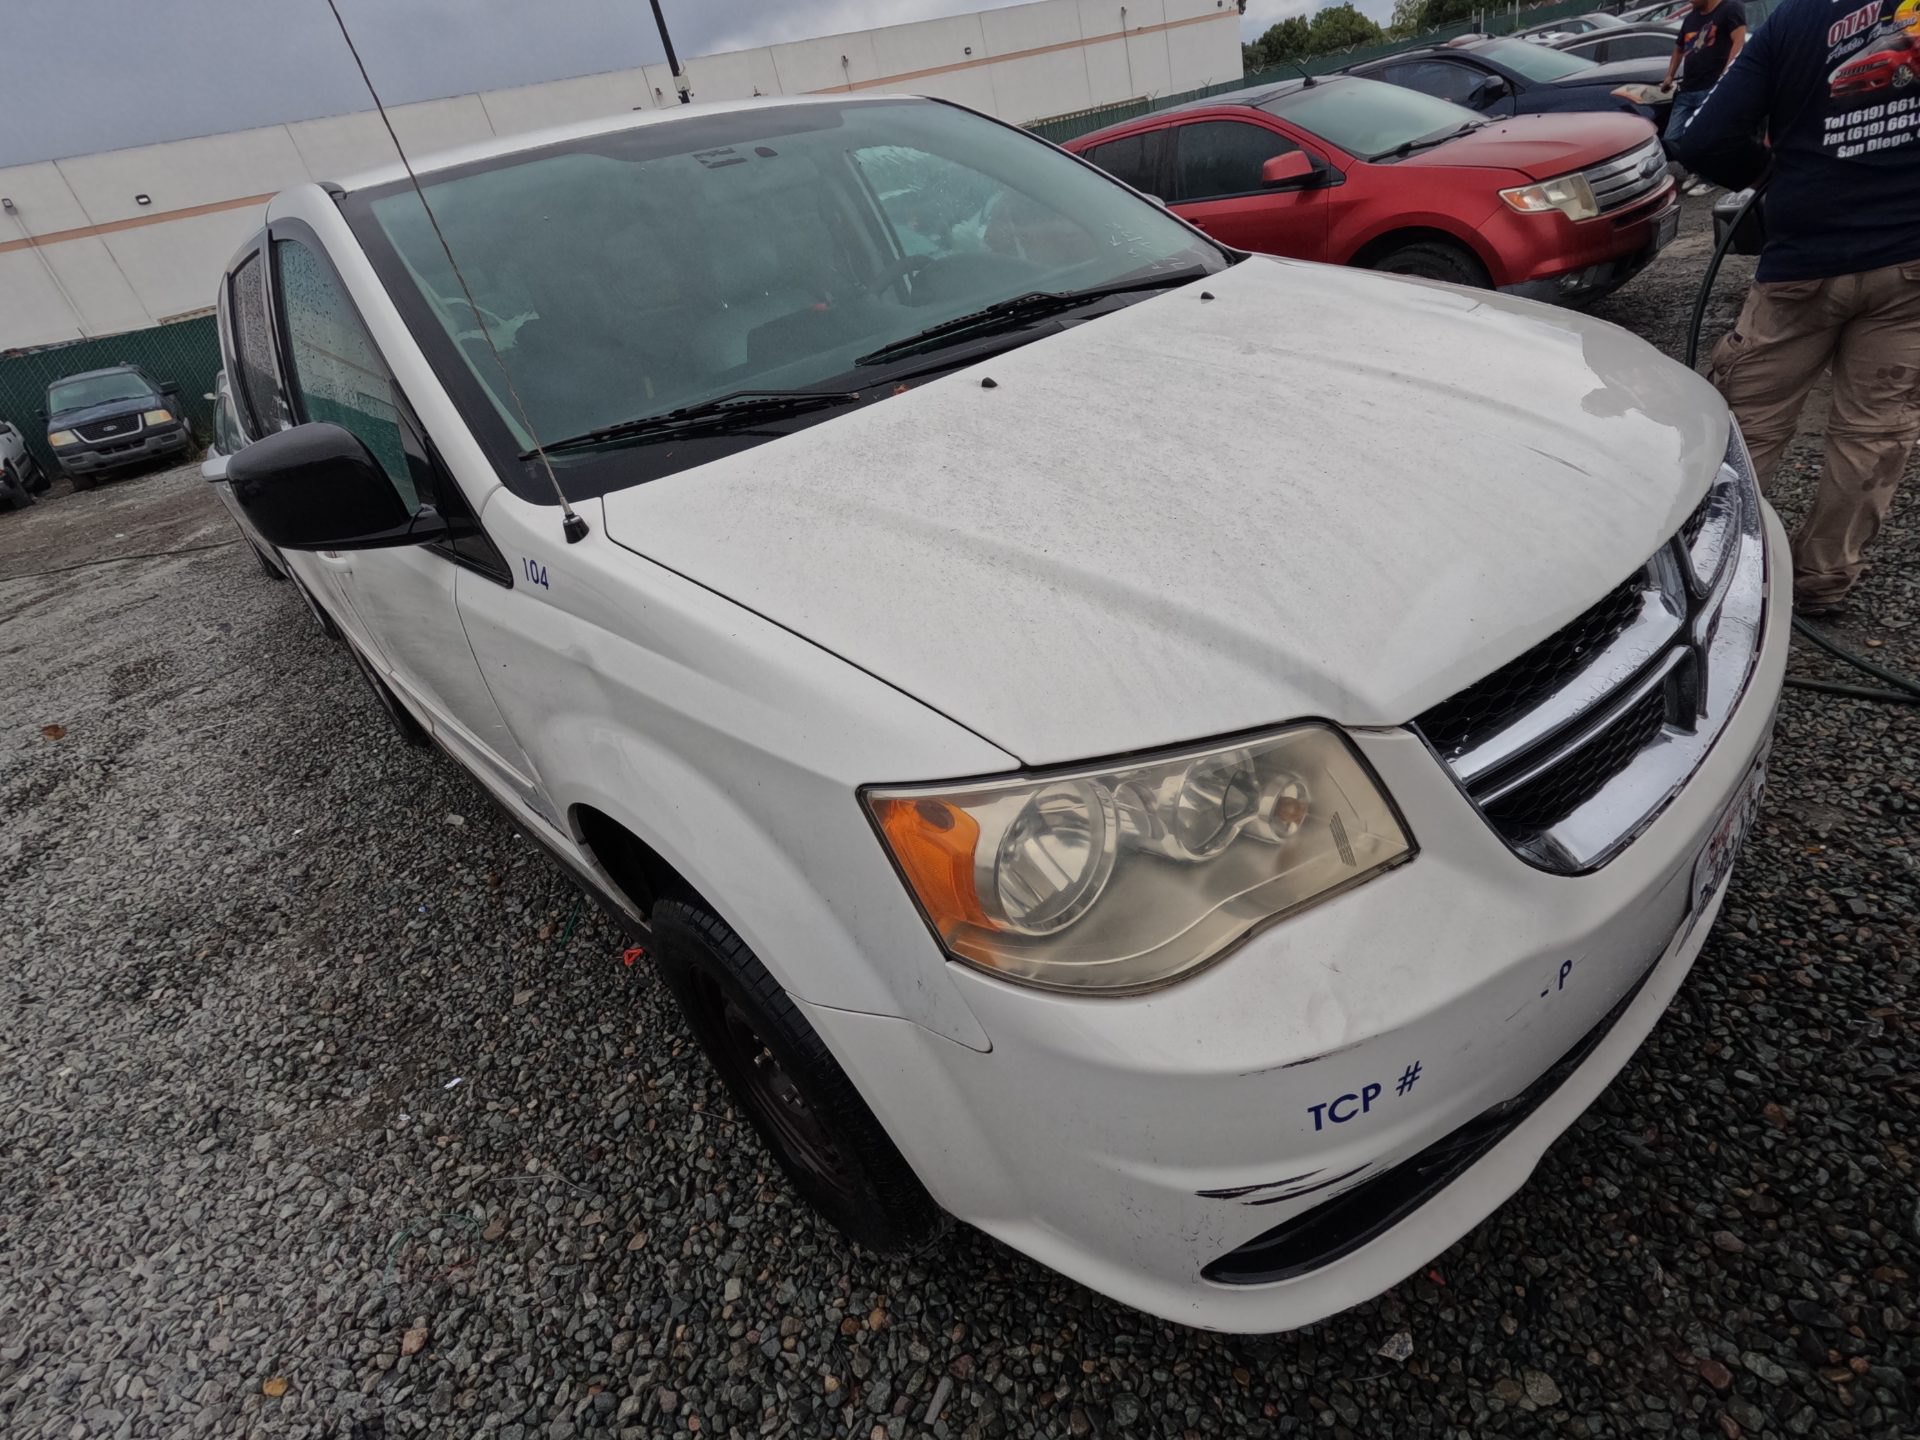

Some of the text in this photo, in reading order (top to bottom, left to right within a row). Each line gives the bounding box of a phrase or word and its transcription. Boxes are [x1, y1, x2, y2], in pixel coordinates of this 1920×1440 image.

[1828, 0, 1883, 47] OTAY
[1823, 112, 1920, 146] Fax (619) 661.
[1824, 96, 1920, 130] Tel (619) 661.
[1837, 143, 1865, 158] San
[522, 557, 549, 590] 104
[1307, 1082, 1382, 1131] TCP
[1396, 1060, 1422, 1096] #
